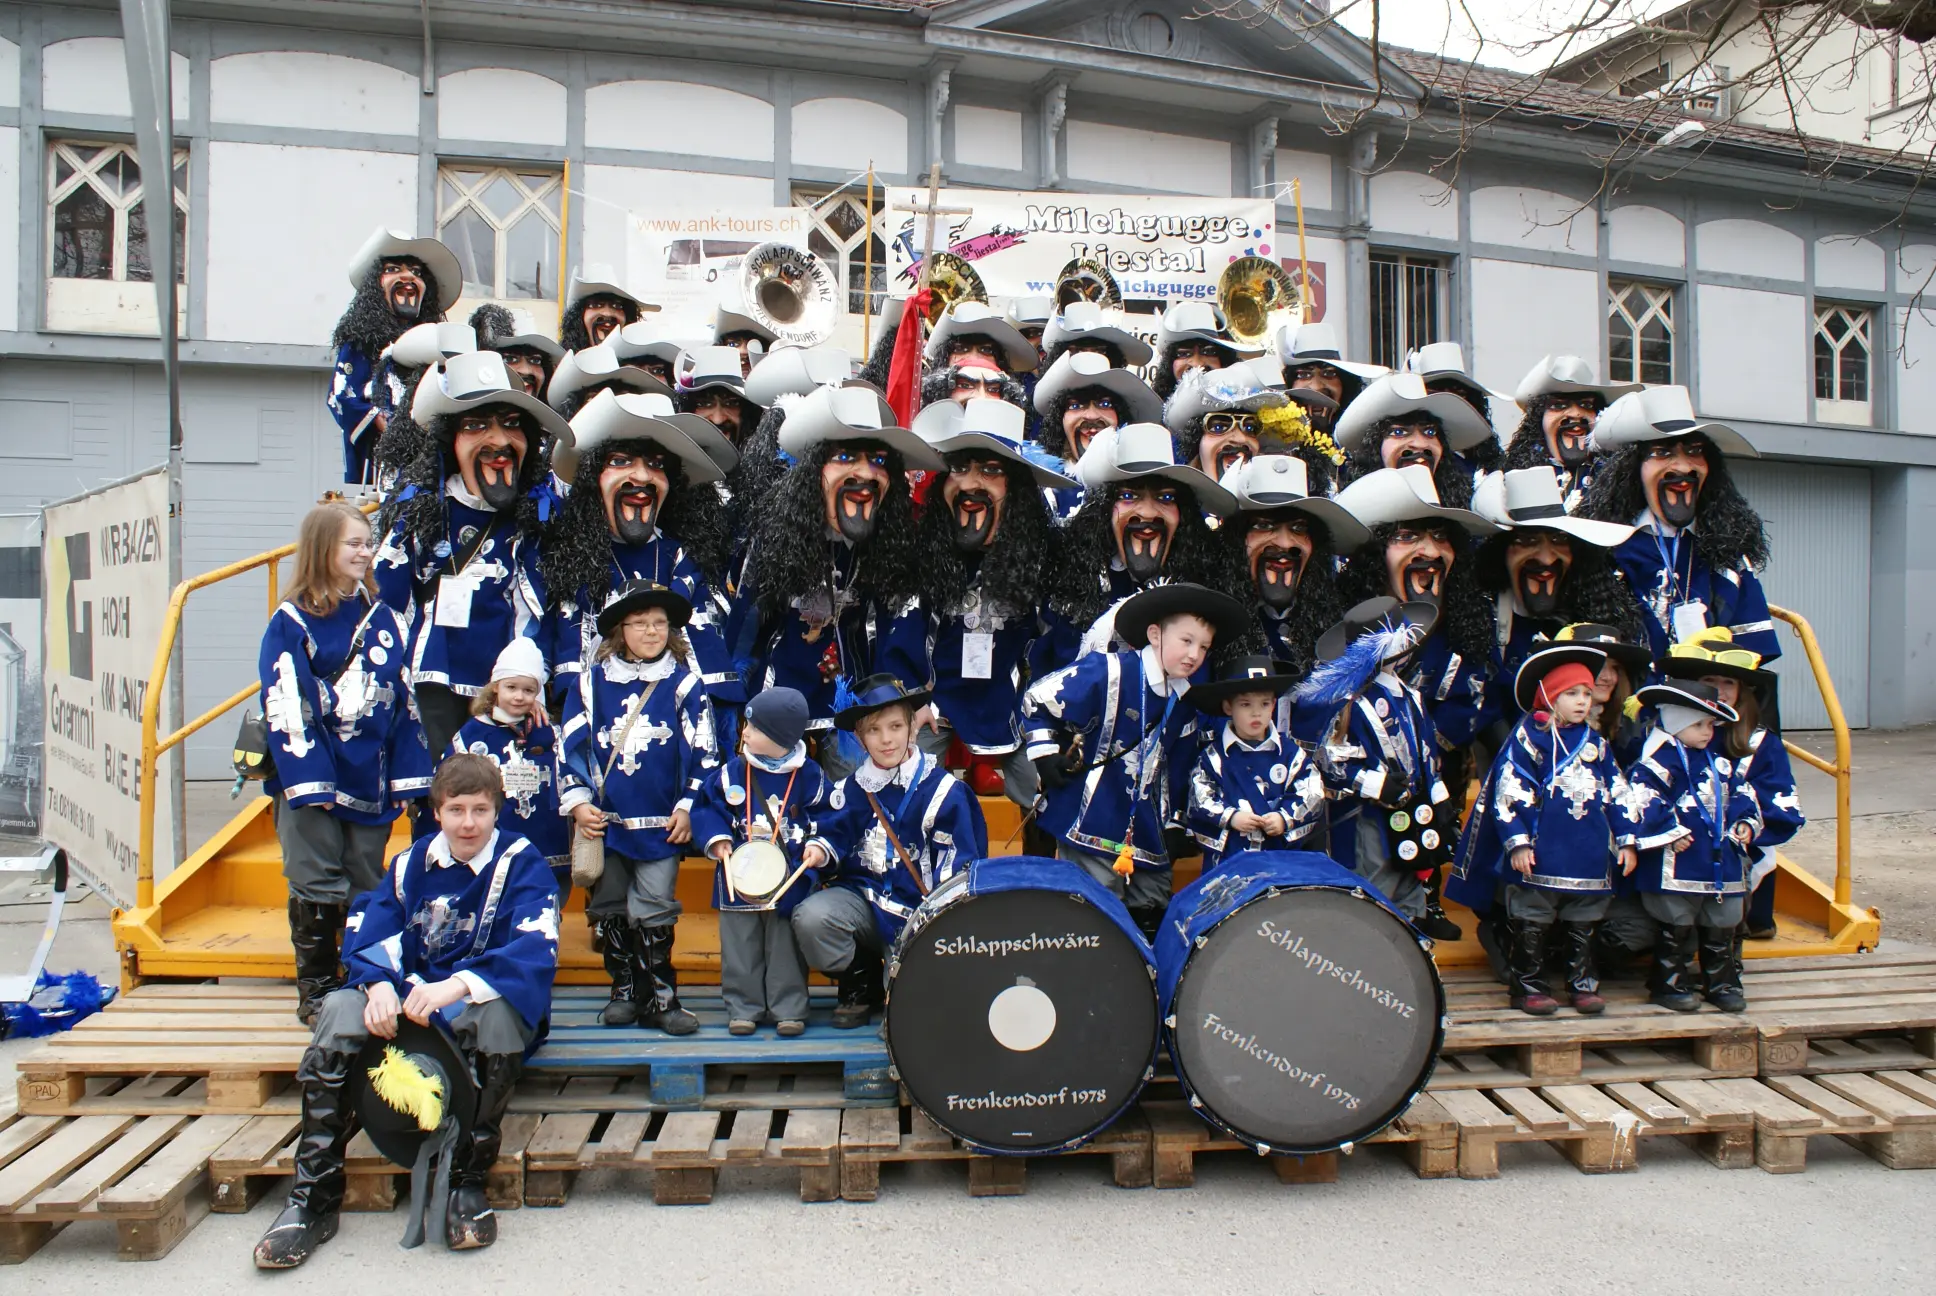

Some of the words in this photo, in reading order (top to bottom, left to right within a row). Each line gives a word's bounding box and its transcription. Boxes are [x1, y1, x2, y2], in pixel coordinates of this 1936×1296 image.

[636, 215, 801, 232] www.ank-tours.ch
[1025, 204, 1249, 243] Milchgugge
[934, 932, 1100, 957] Schlappschwänz
[1256, 920, 1416, 1018] Schlappschwänz
[1202, 1013, 1326, 1088] Frenkendorf
[1322, 1083, 1361, 1110] 1978
[946, 1086, 1068, 1111] Frenkendorf
[1071, 1088, 1107, 1105] 1978
